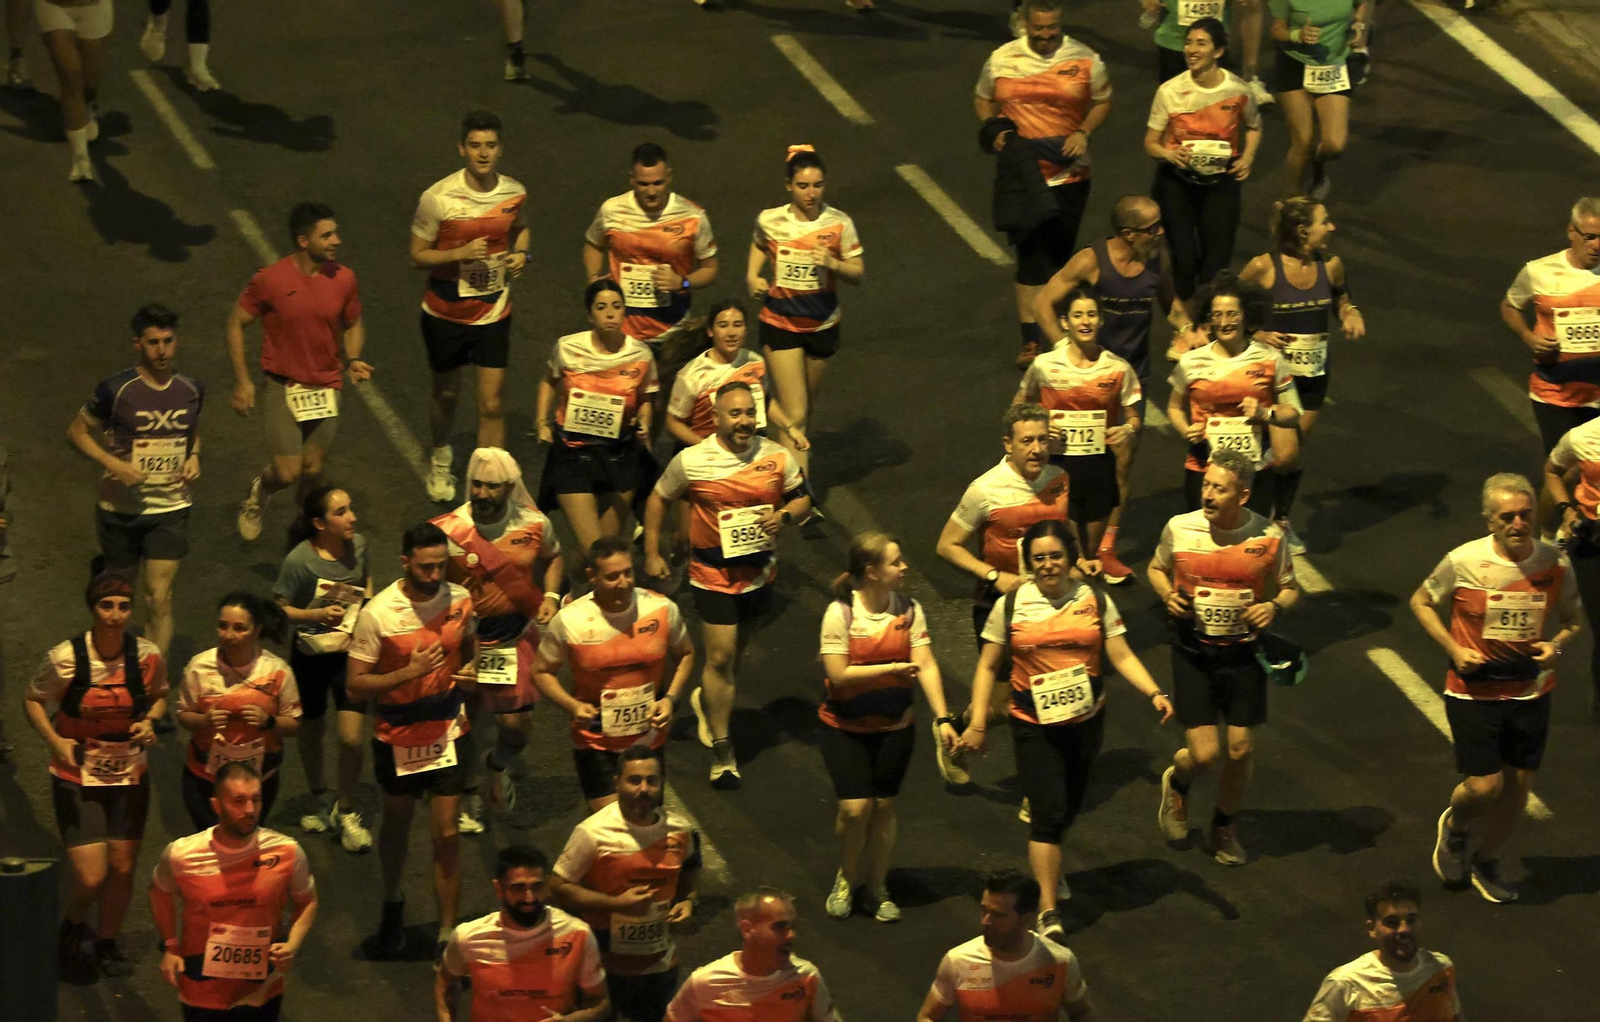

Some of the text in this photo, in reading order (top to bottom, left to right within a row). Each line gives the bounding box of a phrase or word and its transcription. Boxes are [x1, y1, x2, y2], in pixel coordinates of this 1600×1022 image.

[785, 264, 817, 278] 3574
[136, 409, 189, 431] DXC
[573, 408, 615, 425] 13566
[1216, 436, 1251, 450] 5293
[139, 456, 179, 472] 16219
[731, 524, 764, 543] 9592
[1204, 608, 1239, 623] 9593
[1500, 610, 1528, 627] 613
[479, 656, 506, 671] 512
[1039, 686, 1085, 710] 24693
[613, 704, 647, 723] 7517
[211, 945, 262, 964] 20685
